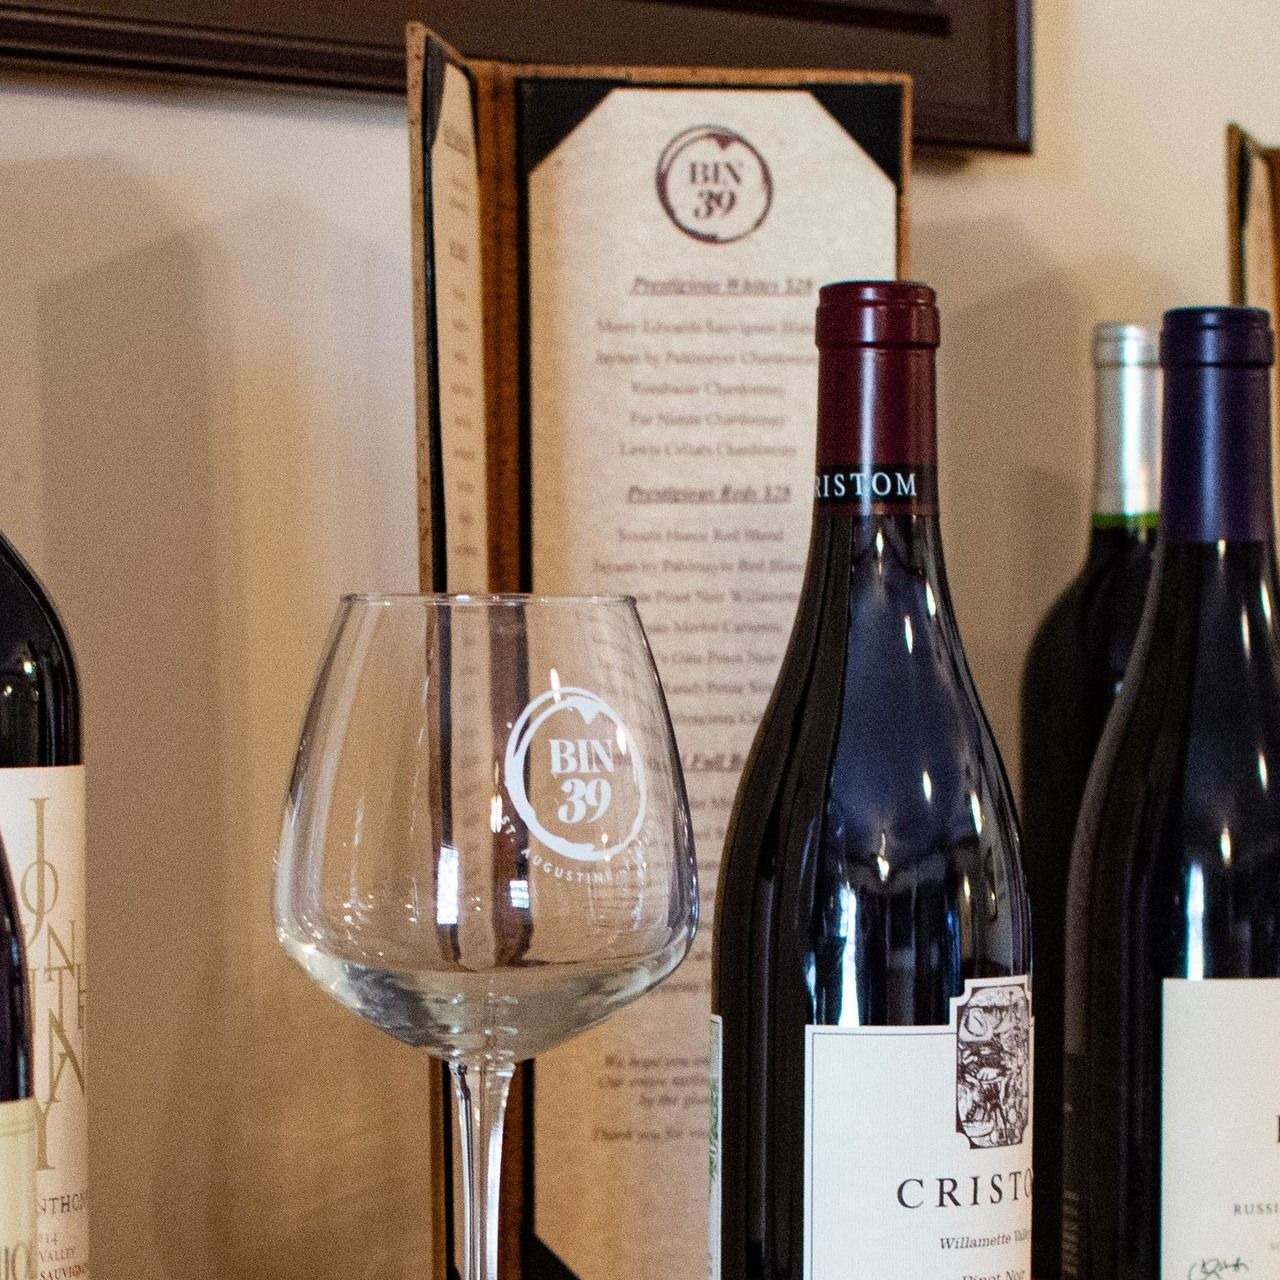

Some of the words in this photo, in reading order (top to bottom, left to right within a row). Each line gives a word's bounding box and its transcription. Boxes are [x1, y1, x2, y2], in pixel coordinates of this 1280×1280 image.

[688, 160, 744, 186] BIN
[693, 188, 737, 219] 39
[548, 738, 616, 773] BIN
[557, 778, 612, 824] 39
[940, 1233, 1012, 1251] Willamette
